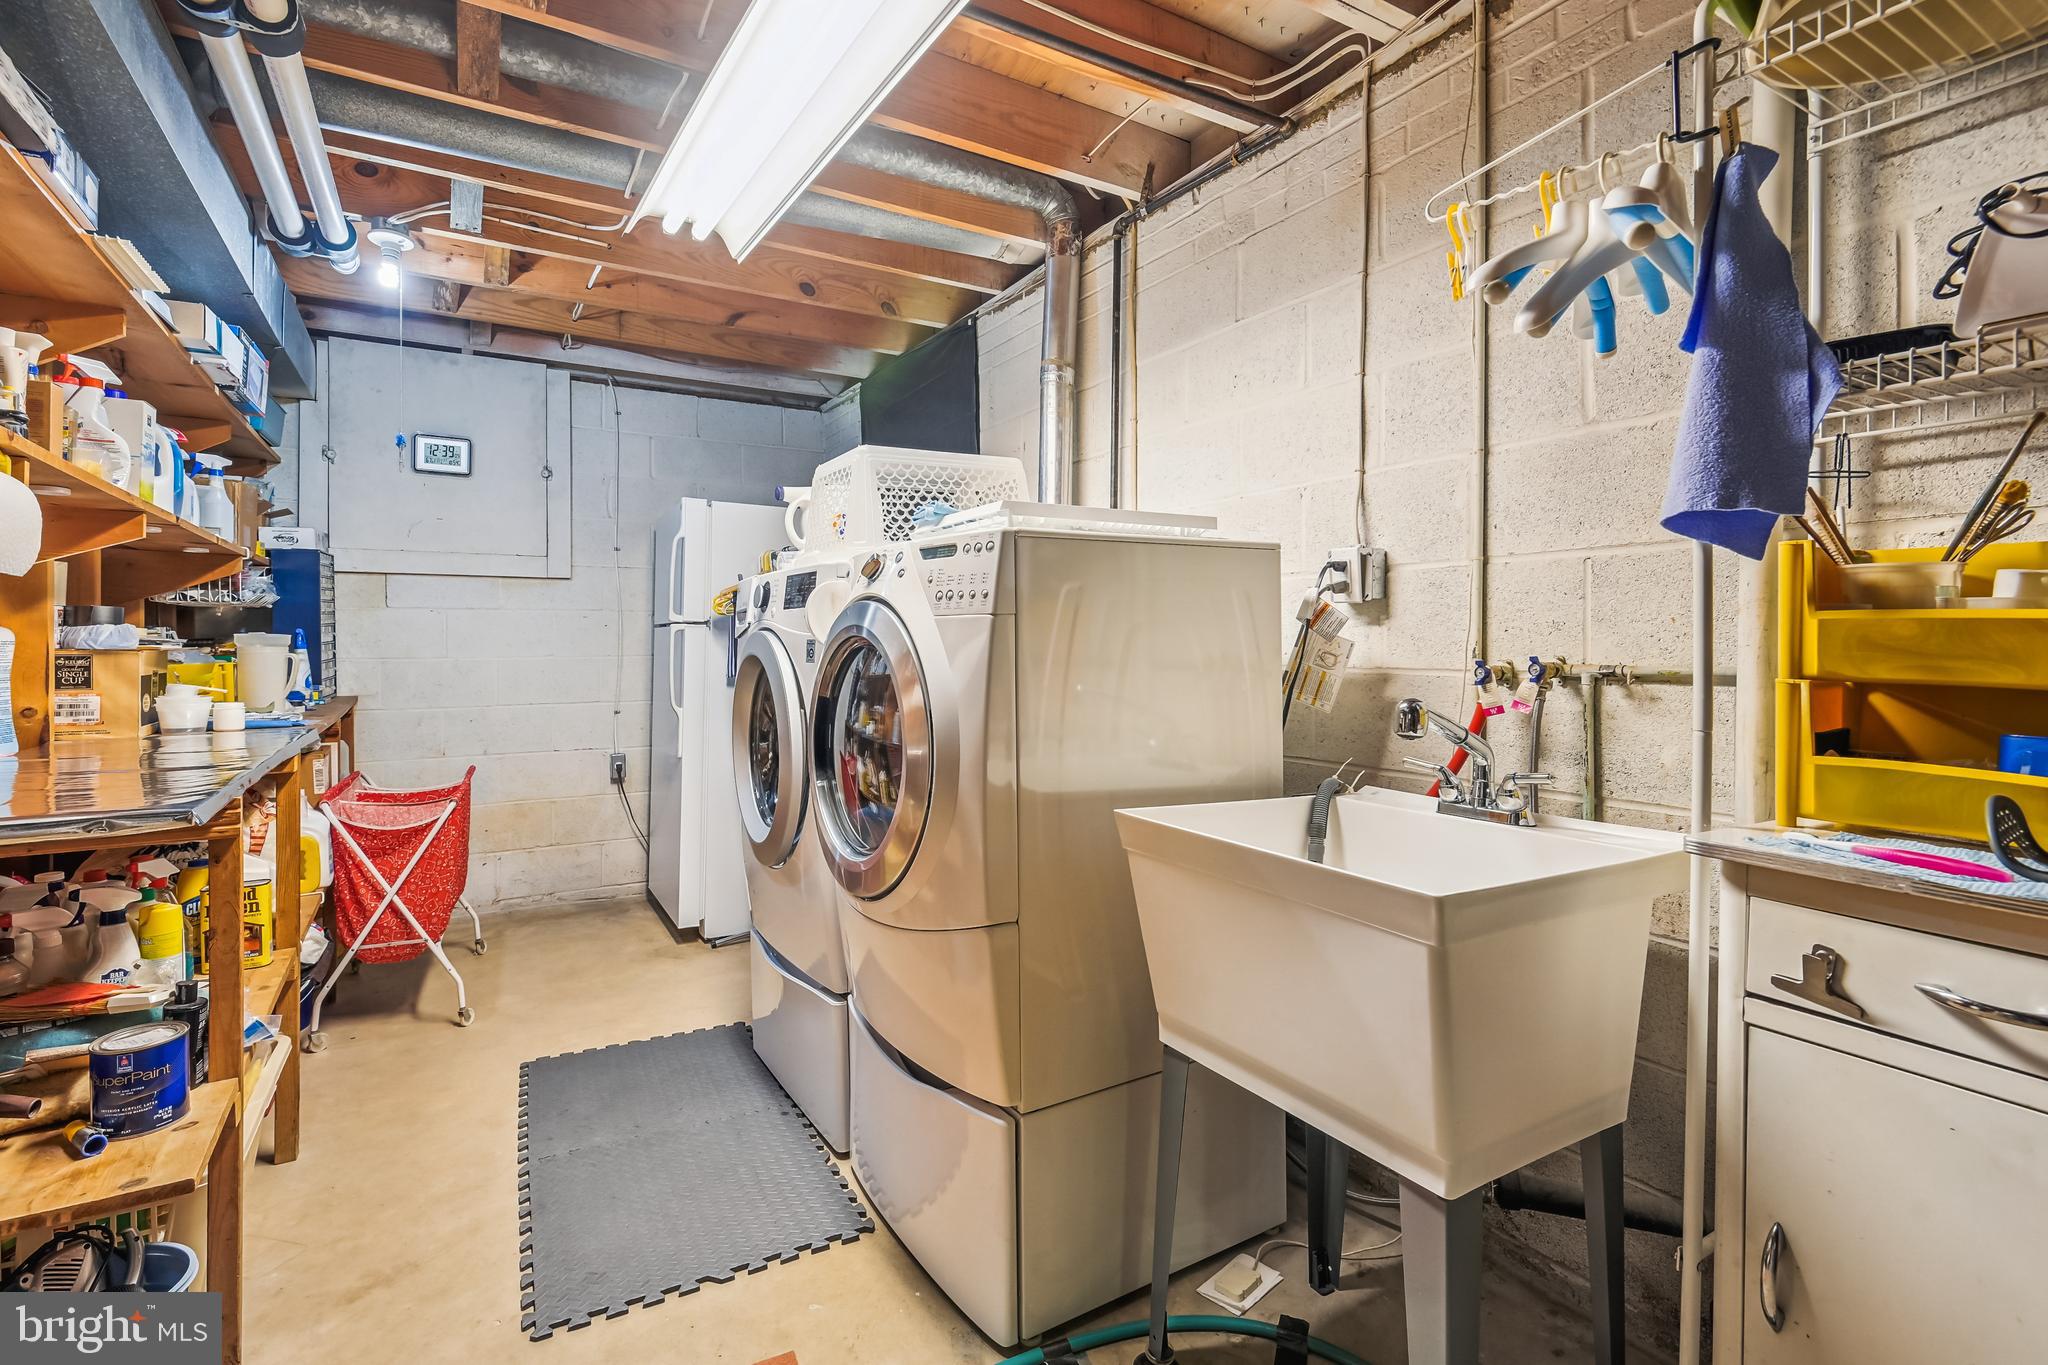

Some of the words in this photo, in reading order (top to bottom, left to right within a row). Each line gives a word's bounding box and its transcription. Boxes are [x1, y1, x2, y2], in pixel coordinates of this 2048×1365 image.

[429, 444, 455, 458] 12:39
[186, 902, 200, 915] CL
[110, 971, 124, 979] BAR
[94, 1063, 171, 1088] SuperPaint
[121, 1104, 142, 1112] ACRYLIC
